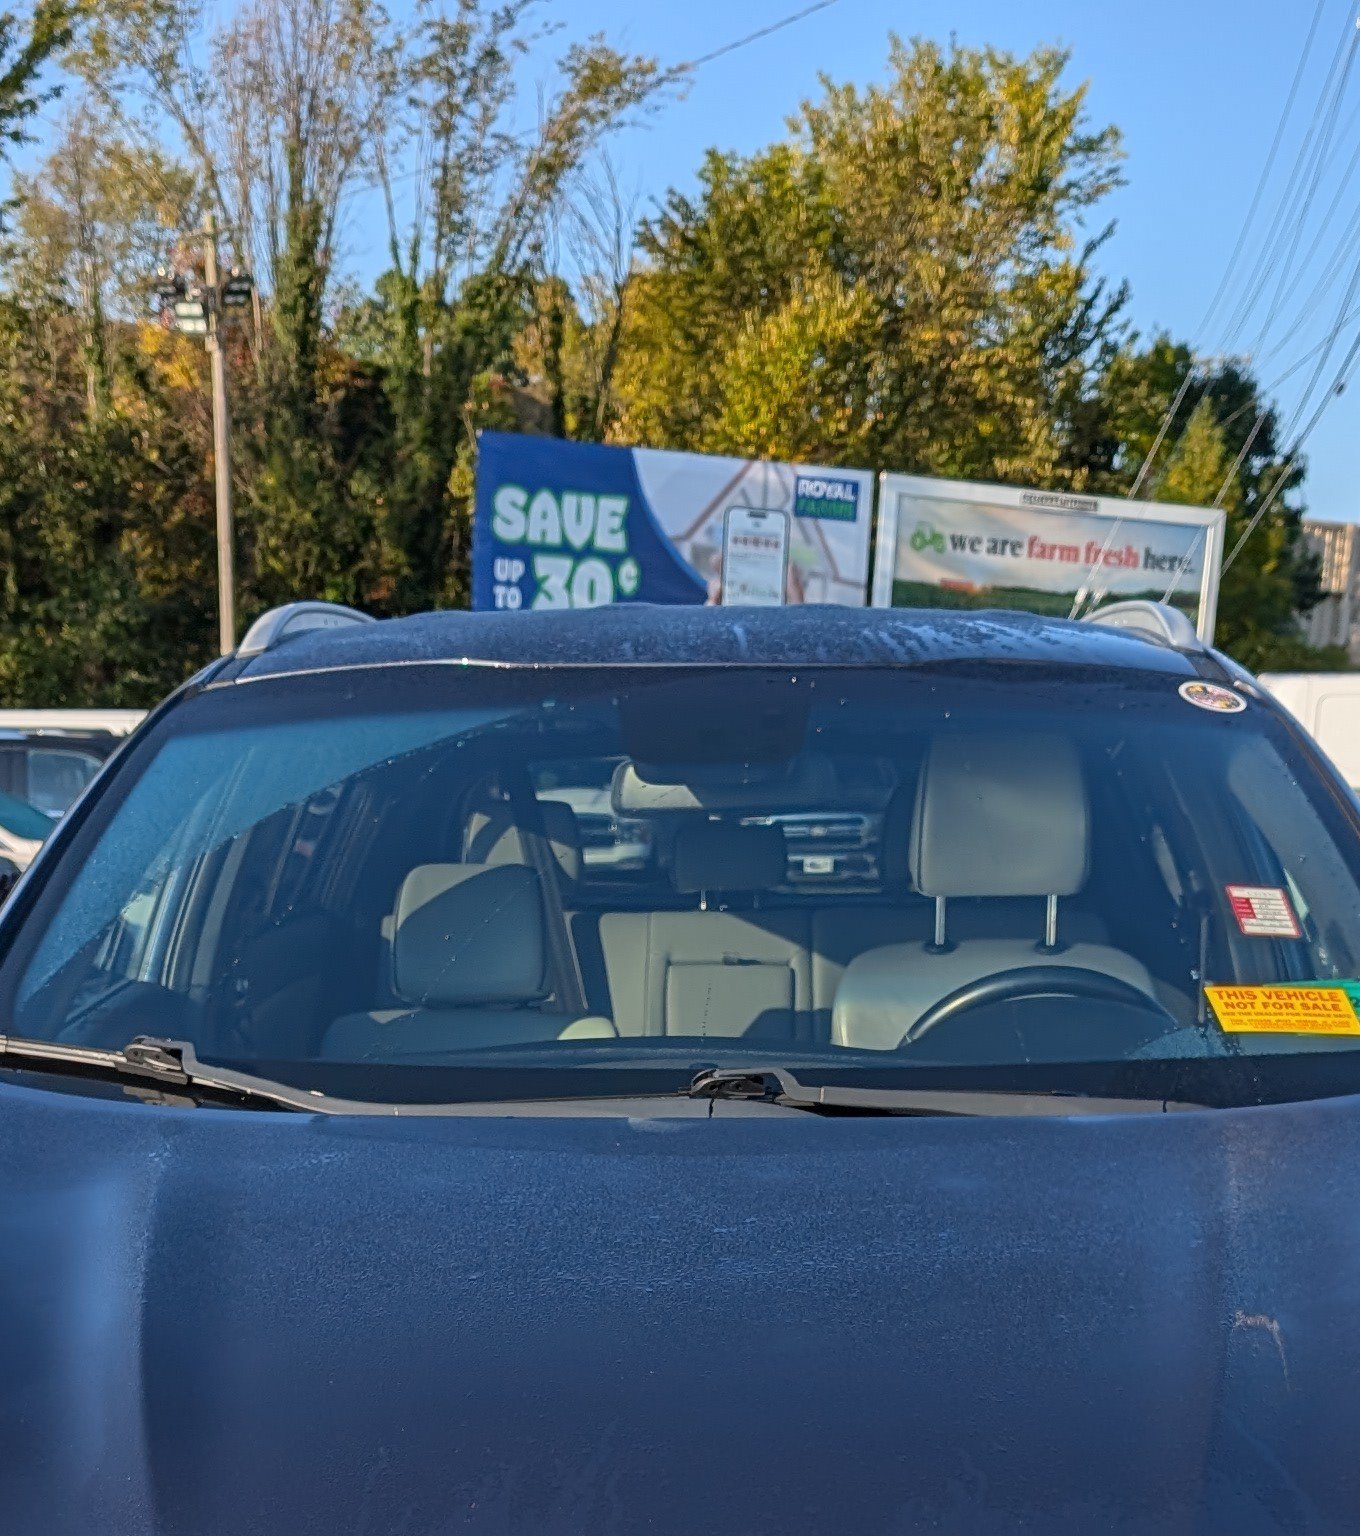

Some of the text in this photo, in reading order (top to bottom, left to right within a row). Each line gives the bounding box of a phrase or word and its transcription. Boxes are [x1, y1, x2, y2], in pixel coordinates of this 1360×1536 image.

[492, 485, 628, 551] SAVE
[950, 533, 983, 552] we
[987, 537, 1024, 557] are
[1027, 535, 1080, 562] farm
[1084, 540, 1139, 569] fresh
[493, 558, 526, 583] UP
[493, 585, 523, 609] TO
[1214, 990, 1340, 1002] THIS VEHICLE
[1224, 1001, 1343, 1012] NOT FOR SALE
